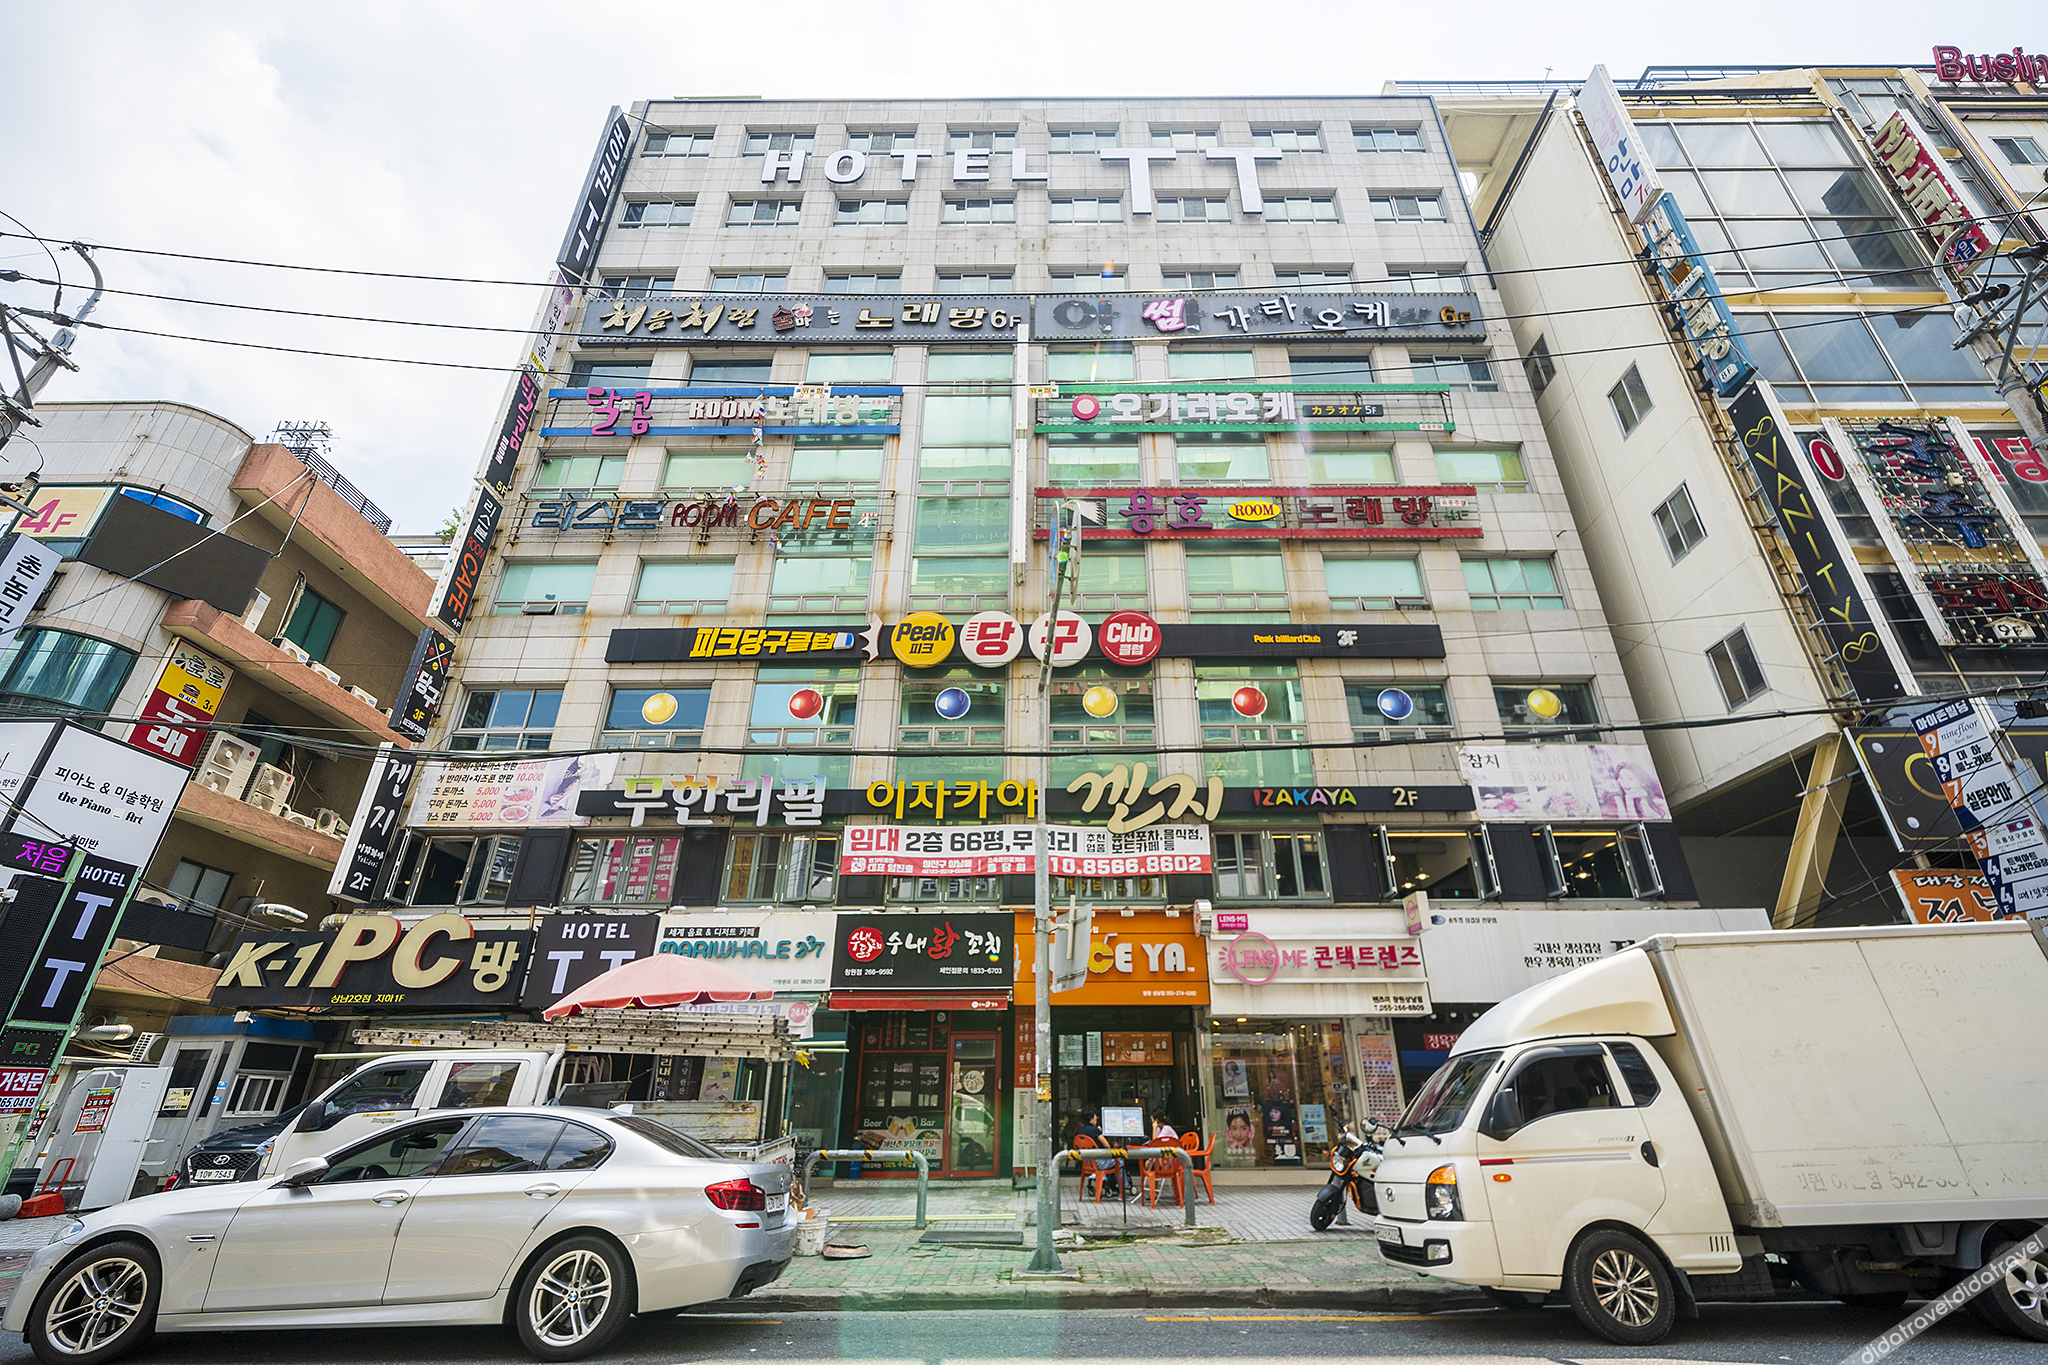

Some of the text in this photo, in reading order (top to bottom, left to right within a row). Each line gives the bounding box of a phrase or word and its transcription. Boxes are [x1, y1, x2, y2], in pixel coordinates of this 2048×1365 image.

[575, 122, 626, 262] HOTEL TT
[761, 147, 1284, 215] HOTEL TT
[599, 301, 759, 335] 처음처럼
[855, 302, 989, 329] 노래방
[990, 309, 1021, 328] 6F
[1213, 295, 1391, 333] 가라오케
[1440, 305, 1472, 327] 6F
[586, 387, 653, 436] 달콤
[689, 395, 864, 426] ROOM 노래방
[870, 409, 894, 420] 5F
[1112, 392, 1296, 422] 오가라오케
[1311, 405, 1378, 416] カラオケ 5F
[495, 434, 510, 464] ROOM
[18, 498, 79, 534] 4F
[671, 499, 856, 531] ROOM CAFE
[1119, 490, 1213, 533] 용호
[1234, 502, 1276, 518] ROOM
[1300, 496, 1432, 525] 노래방
[1754, 435, 1856, 633] VANITY
[466, 536, 487, 561] ROOM
[447, 552, 479, 619] CAFE
[689, 627, 836, 658] 피크당구클럽
[895, 622, 948, 643] Peak
[974, 622, 1015, 657] 당
[1040, 619, 1080, 655] 구
[1106, 622, 1153, 644] Club
[1253, 634, 1274, 644] Peak
[1336, 629, 1358, 648] 3F
[909, 643, 934, 655] 피크
[1118, 643, 1145, 656] 클럽
[414, 669, 440, 708] 당구
[202, 699, 214, 712] 3F
[412, 708, 426, 722] 3F
[1941, 718, 1979, 742] ninefloor
[1467, 753, 1500, 769] 참치
[55, 766, 164, 813] 피아노 & 미술학원
[516, 772, 544, 782] 10,000
[476, 786, 501, 796] 5,000
[613, 774, 828, 828] 무한리필
[866, 779, 1039, 820] 이자카야
[1253, 787, 1419, 807] IZAKAYA 2F
[58, 790, 144, 826] the Piano Art
[472, 799, 497, 809] 5,000
[468, 812, 493, 822] 5,000
[850, 828, 900, 852] 임대
[905, 831, 943, 853] 2층
[15, 840, 68, 874] 처음
[1050, 856, 1203, 876] 10.8566.8602
[80, 865, 126, 888] HOTEL
[349, 871, 372, 892] 2F
[561, 922, 631, 940] HOTEL
[668, 927, 686, 937] 세계
[687, 927, 703, 937] 음료
[713, 927, 737, 937] 디저트
[927, 921, 961, 960] 닭
[658, 935, 826, 960] MARIWHALE 237
[1141, 942, 1186, 973] YA
[1231, 945, 1422, 970] LENS ME 콘택트렌즈
[1533, 942, 1562, 955] 국내산
[1563, 942, 1603, 955] 생삼겹살
[215, 940, 324, 989] K-1
[1524, 956, 1543, 969] 한우
[330, 993, 372, 1005] 상남2호점
[863, 1117, 936, 1127] Beer Bar
[213, 1170, 233, 1179] 7543
